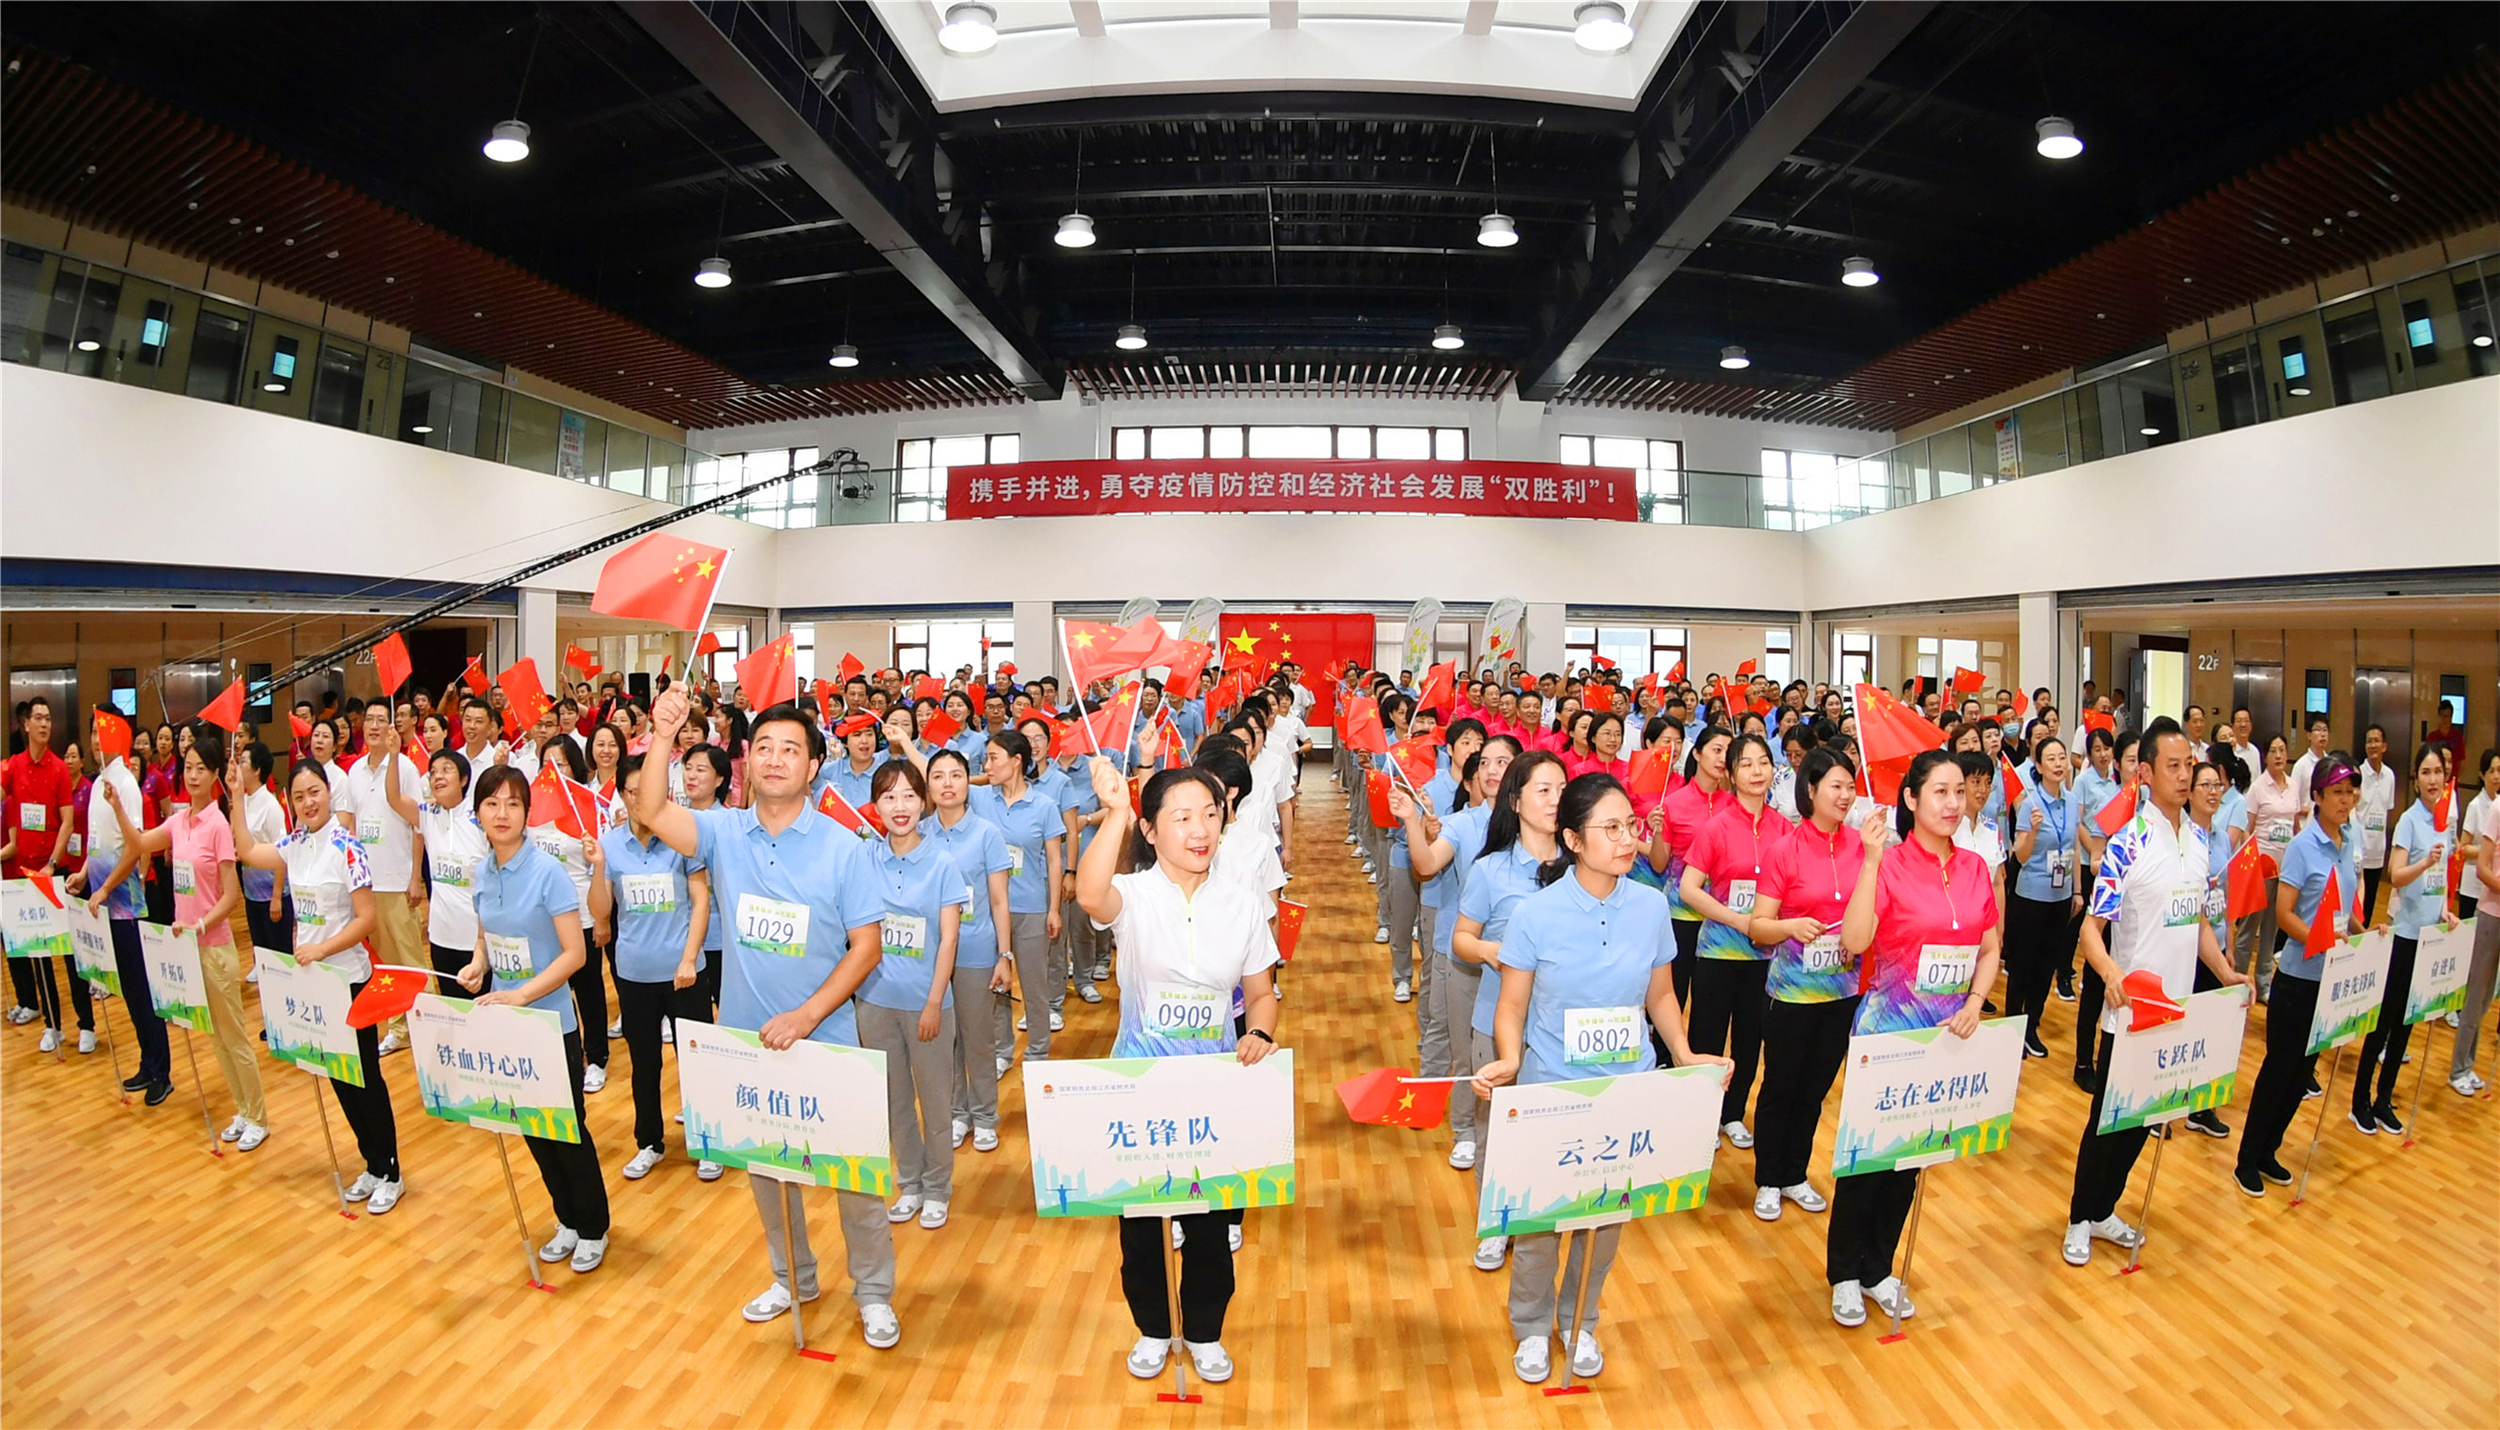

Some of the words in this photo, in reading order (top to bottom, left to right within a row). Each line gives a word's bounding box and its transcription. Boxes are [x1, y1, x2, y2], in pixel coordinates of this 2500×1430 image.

[2198, 654, 2219, 671] 22F
[24, 812, 41, 826] 1609
[360, 824, 380, 839] 1303
[536, 841, 560, 858] 1205
[174, 870, 191, 889] 1318
[437, 862, 463, 881] 1208
[297, 898, 318, 916] 1202
[631, 888, 666, 906] 1103
[2172, 897, 2199, 918] 0601
[746, 915, 795, 946] 1029
[882, 927, 914, 949] 012
[493, 950, 522, 972] 1118
[1812, 948, 1849, 969] 0703
[2430, 956, 2456, 978] 奋进队
[1928, 963, 1968, 985] 0711
[2330, 970, 2377, 1002] 服务先锋队
[285, 996, 327, 1027] 梦之队
[1159, 1003, 1212, 1029] 0909
[1578, 1028, 1630, 1053] 0802
[436, 1043, 540, 1082] 铁血丹心队
[2152, 1038, 2207, 1070] 飞跃队
[1874, 1071, 1990, 1112] 志在必得队
[735, 1083, 825, 1123] 颜值队
[1106, 1116, 1220, 1149] 先锋队
[1556, 1129, 1655, 1167] 云之队
